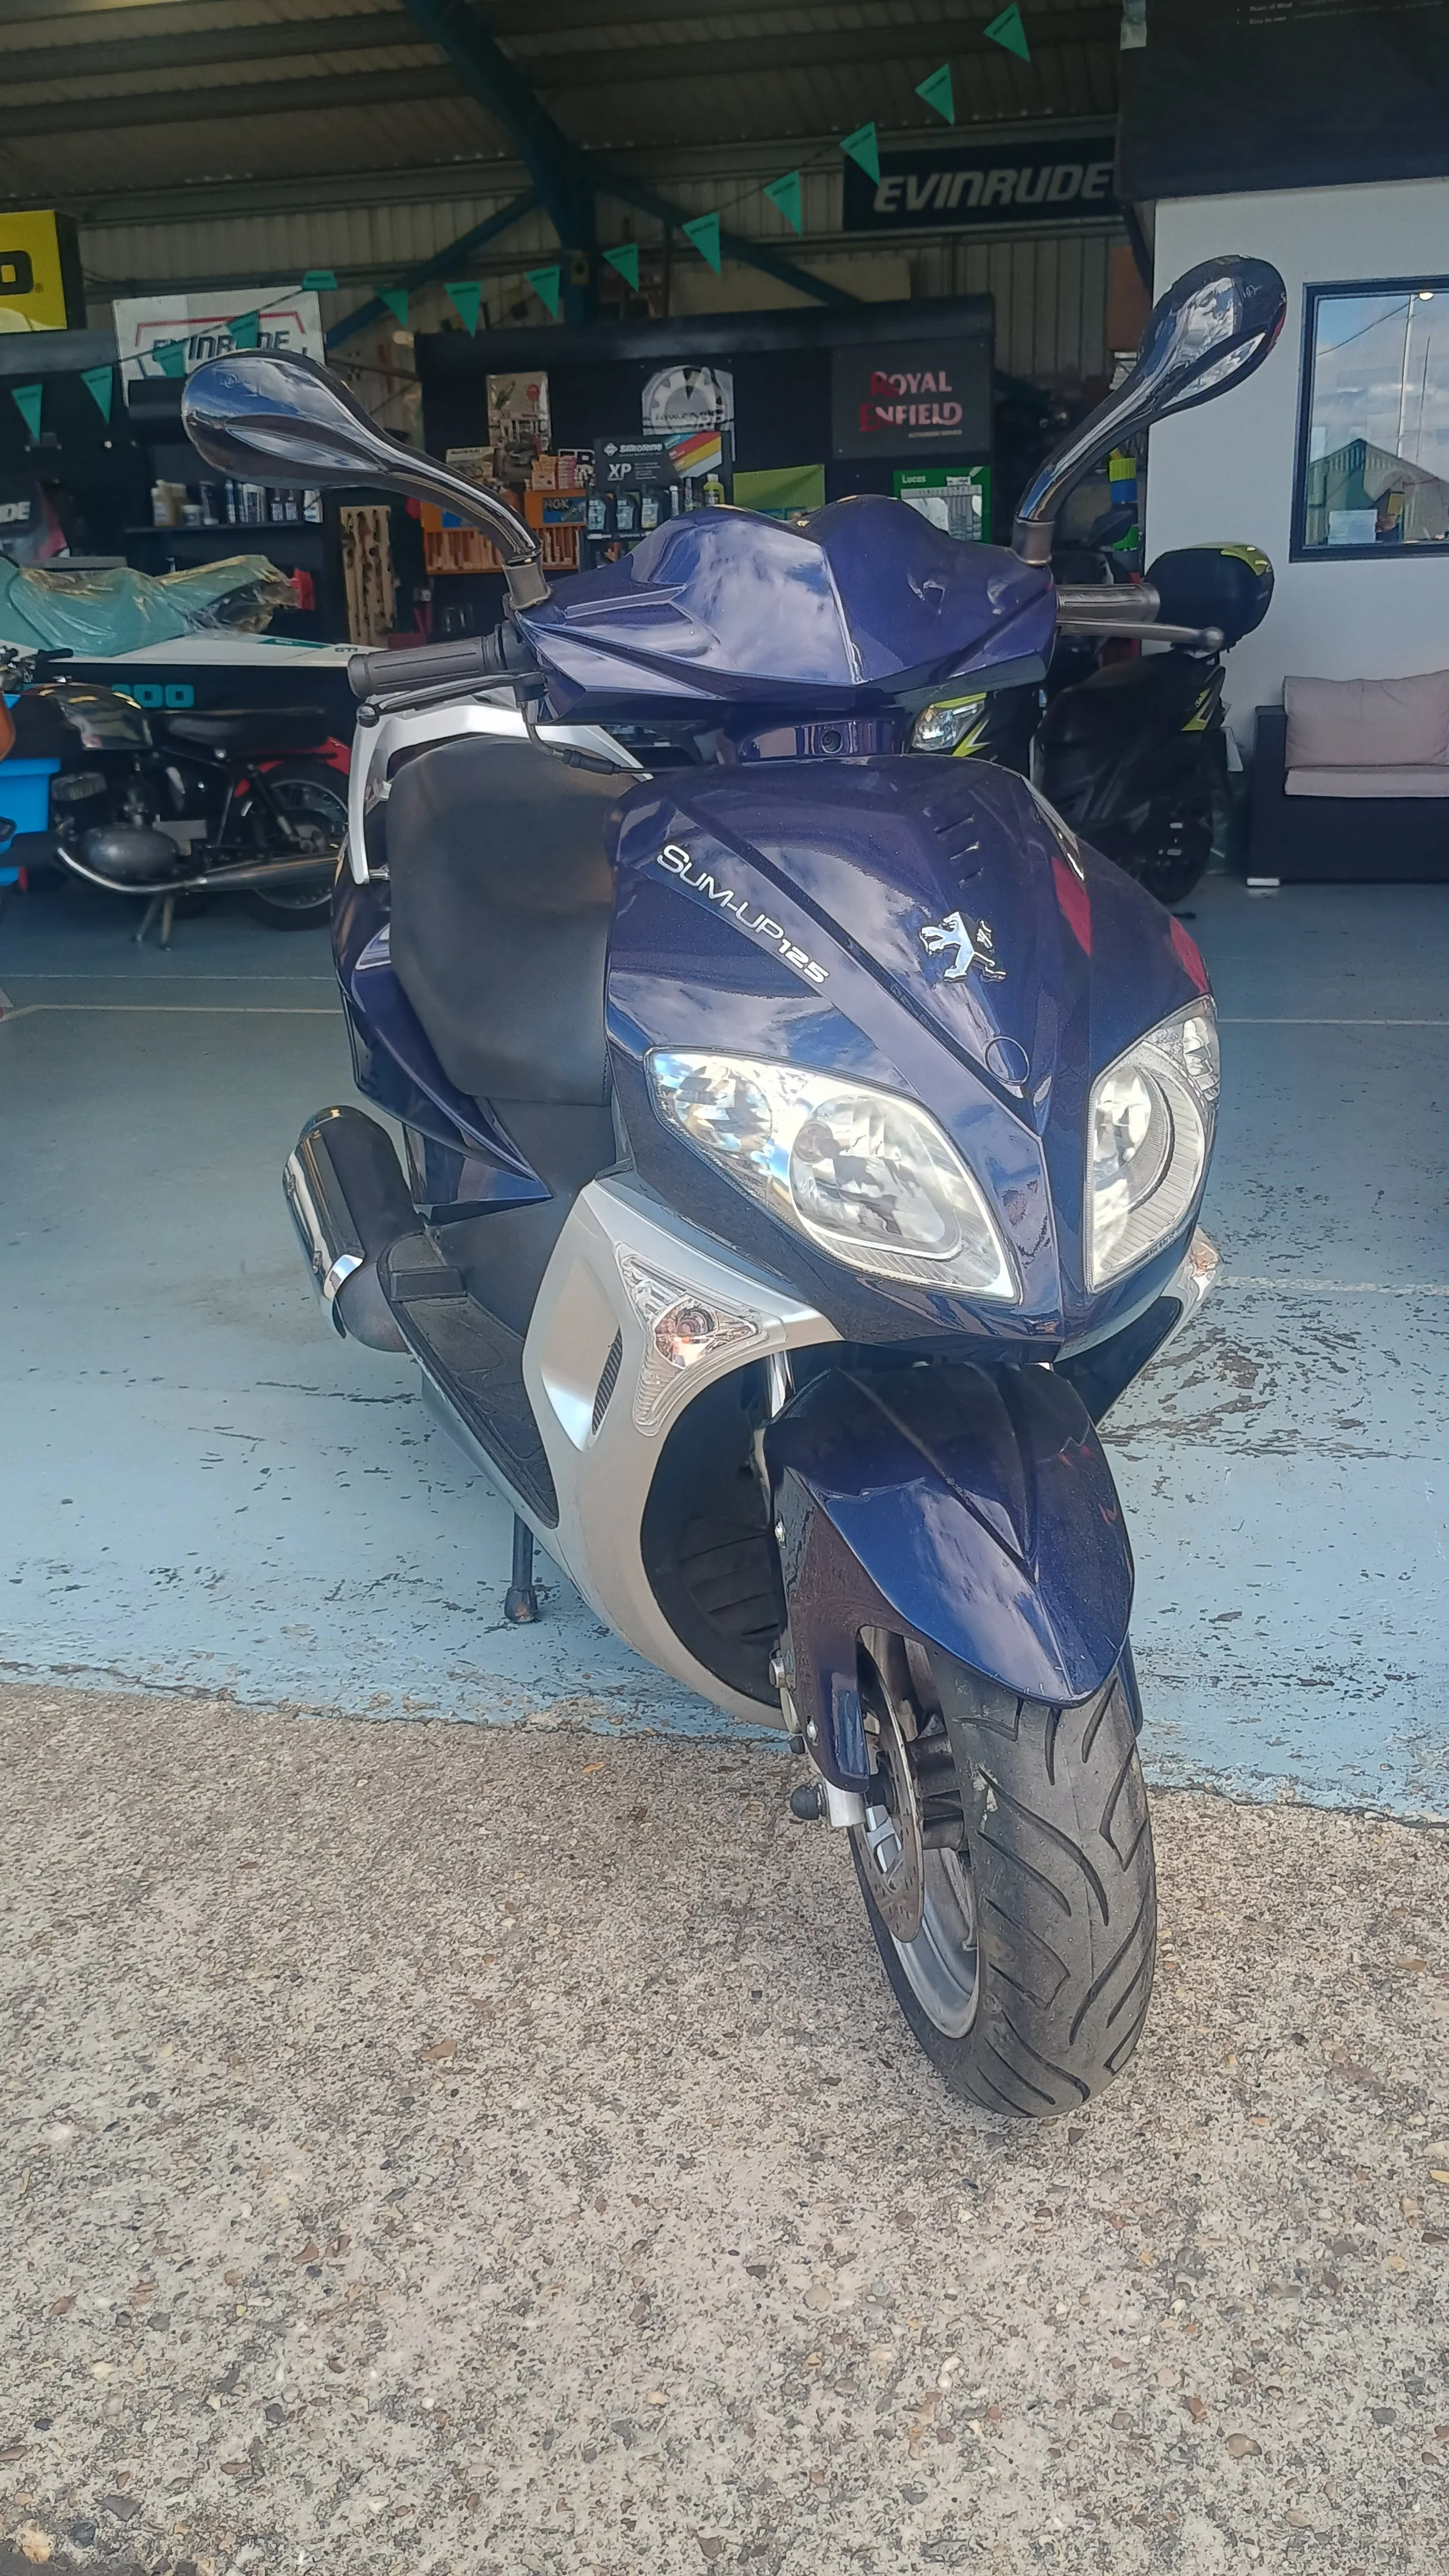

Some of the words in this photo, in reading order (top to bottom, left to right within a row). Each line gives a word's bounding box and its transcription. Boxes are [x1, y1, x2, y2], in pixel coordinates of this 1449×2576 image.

[873, 162, 1113, 213] EVINRUDE
[871, 371, 952, 397] ROYAL
[860, 402, 963, 432] ENFIELD
[607, 463, 632, 481] XP
